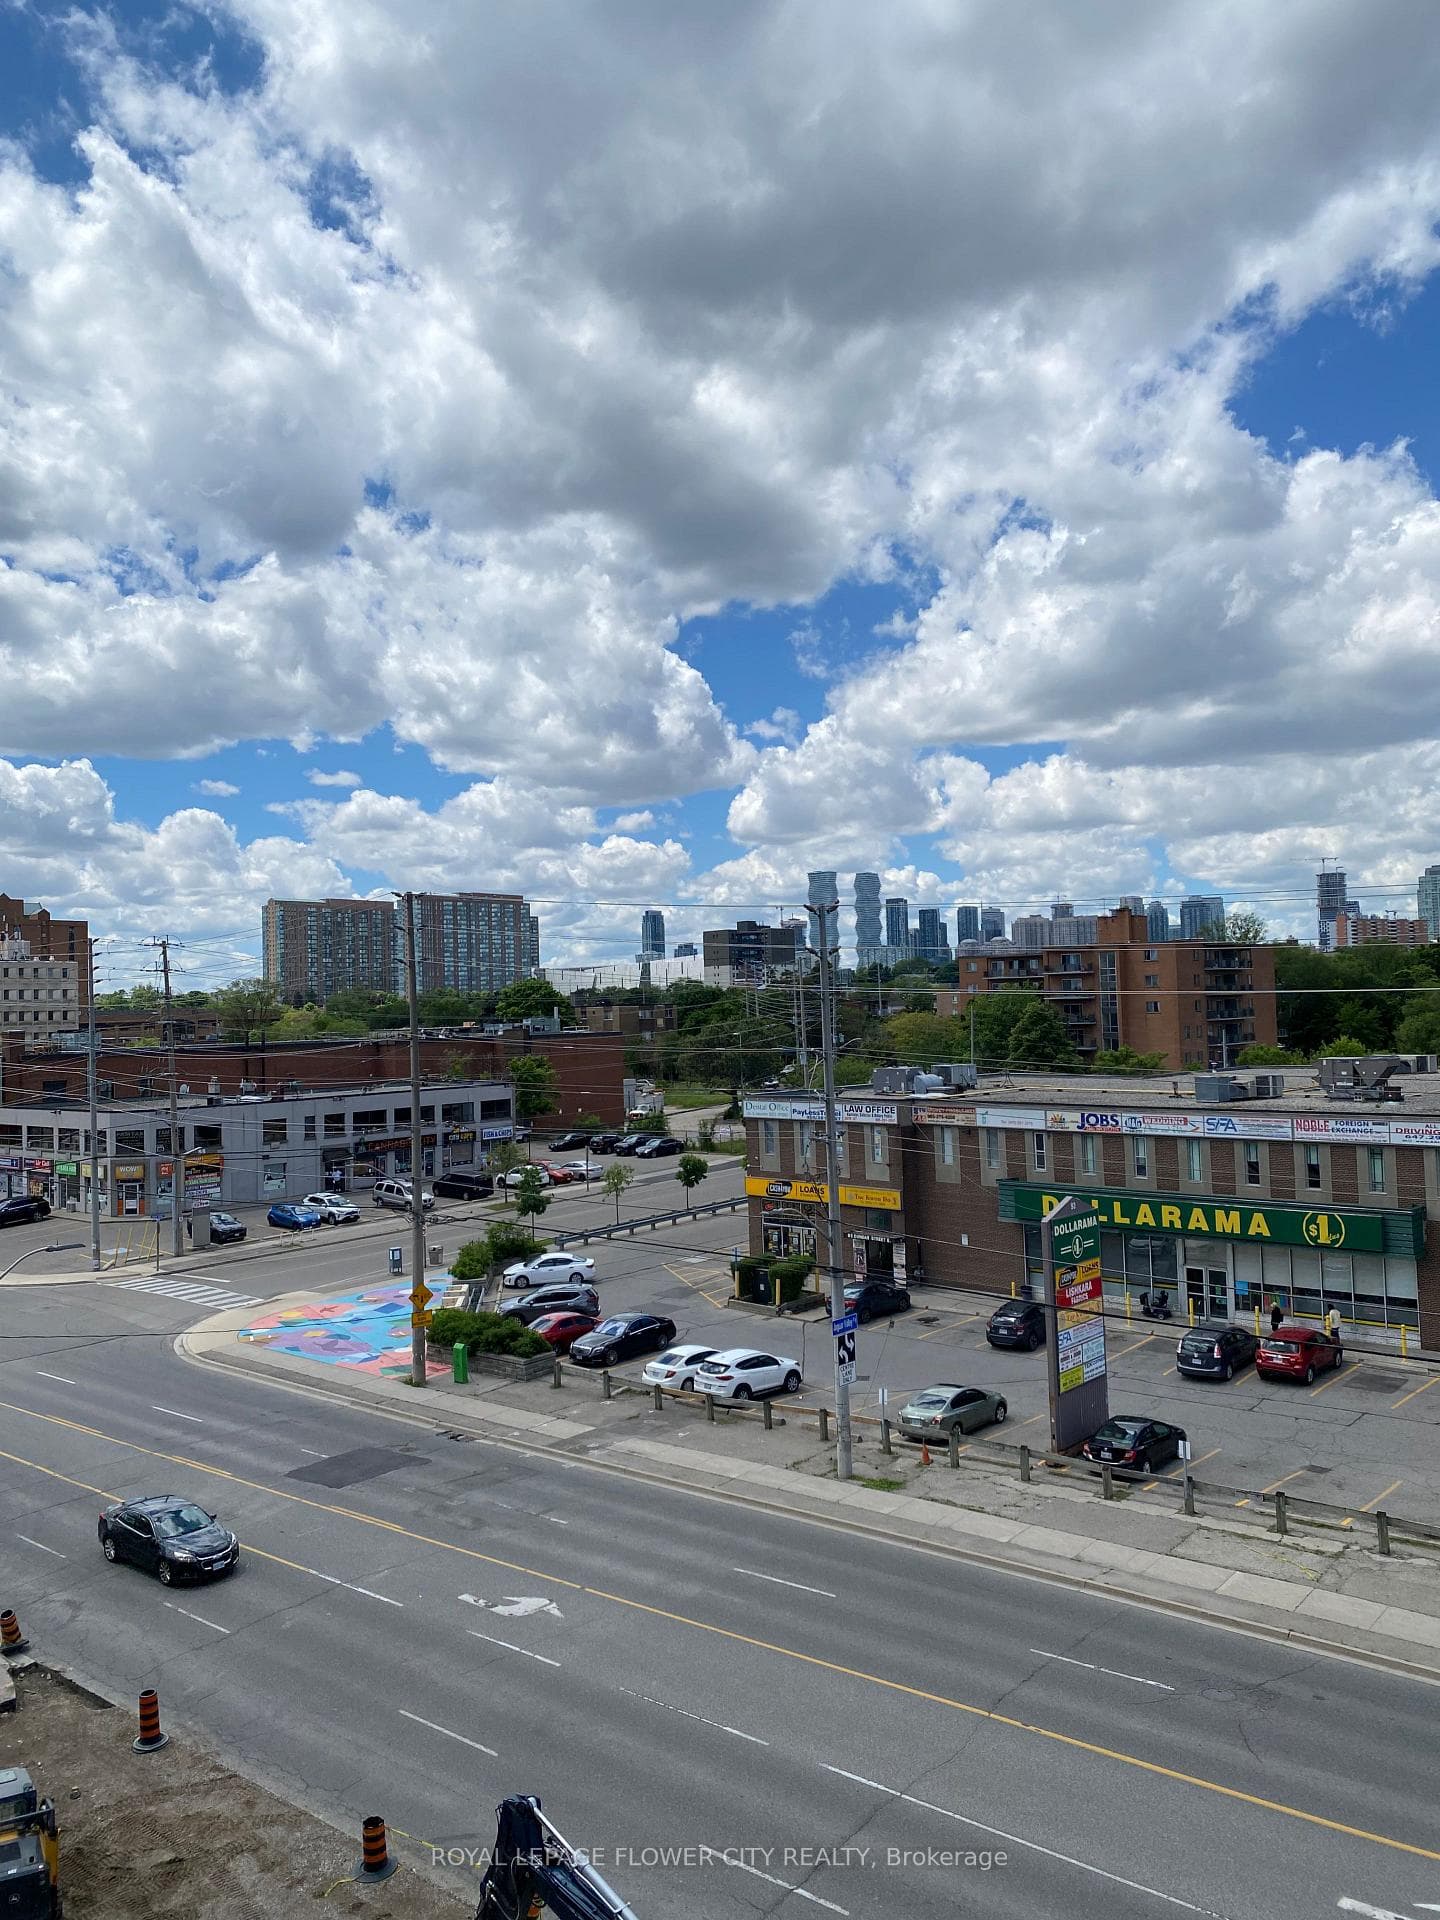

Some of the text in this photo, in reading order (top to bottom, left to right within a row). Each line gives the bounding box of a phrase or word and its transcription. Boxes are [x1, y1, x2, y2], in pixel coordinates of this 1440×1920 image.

[844, 1104, 896, 1114] LAW OFFICE
[1076, 1112, 1120, 1130] JOBS
[1295, 1119, 1329, 1132] NOBLE
[1395, 1127, 1440, 1136] DRIVING
[1042, 1195, 1271, 1237] DLLARAMA
[1054, 1215, 1098, 1237] DOLLARAMA
